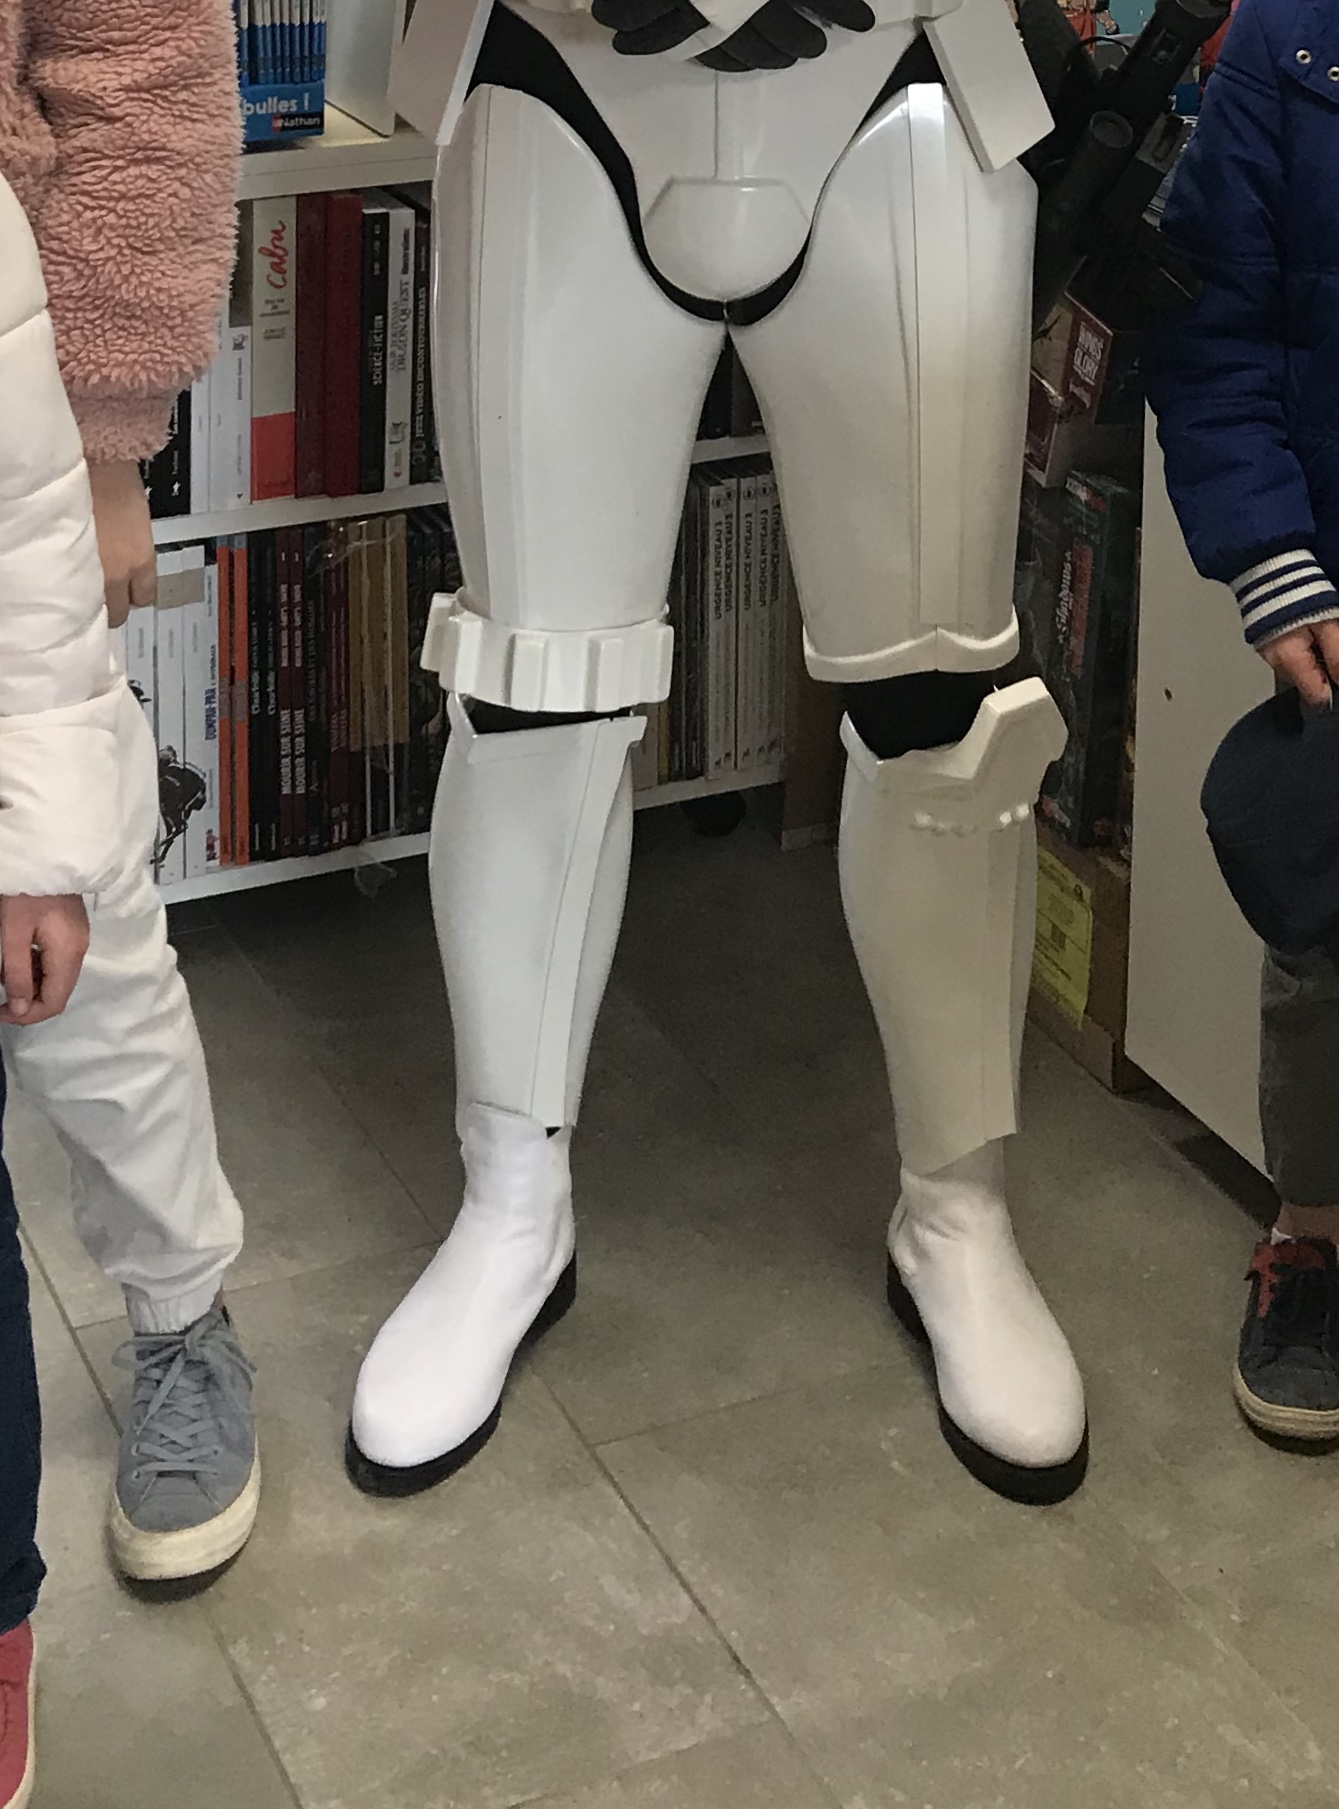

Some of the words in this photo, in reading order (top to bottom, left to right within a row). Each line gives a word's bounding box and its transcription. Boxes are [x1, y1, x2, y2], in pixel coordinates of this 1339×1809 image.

[243, 96, 298, 116] bulles
[281, 116, 321, 129] Nathan
[714, 569, 722, 620] URGENCE
[725, 562, 733, 613] URGENCE
[744, 562, 752, 611] URGENCE
[760, 557, 768, 607] URGENCE
[281, 736, 291, 755] SUR
[294, 736, 305, 755] SUR
[281, 757, 291, 795] MOURIR
[294, 757, 305, 795] MOURIR
